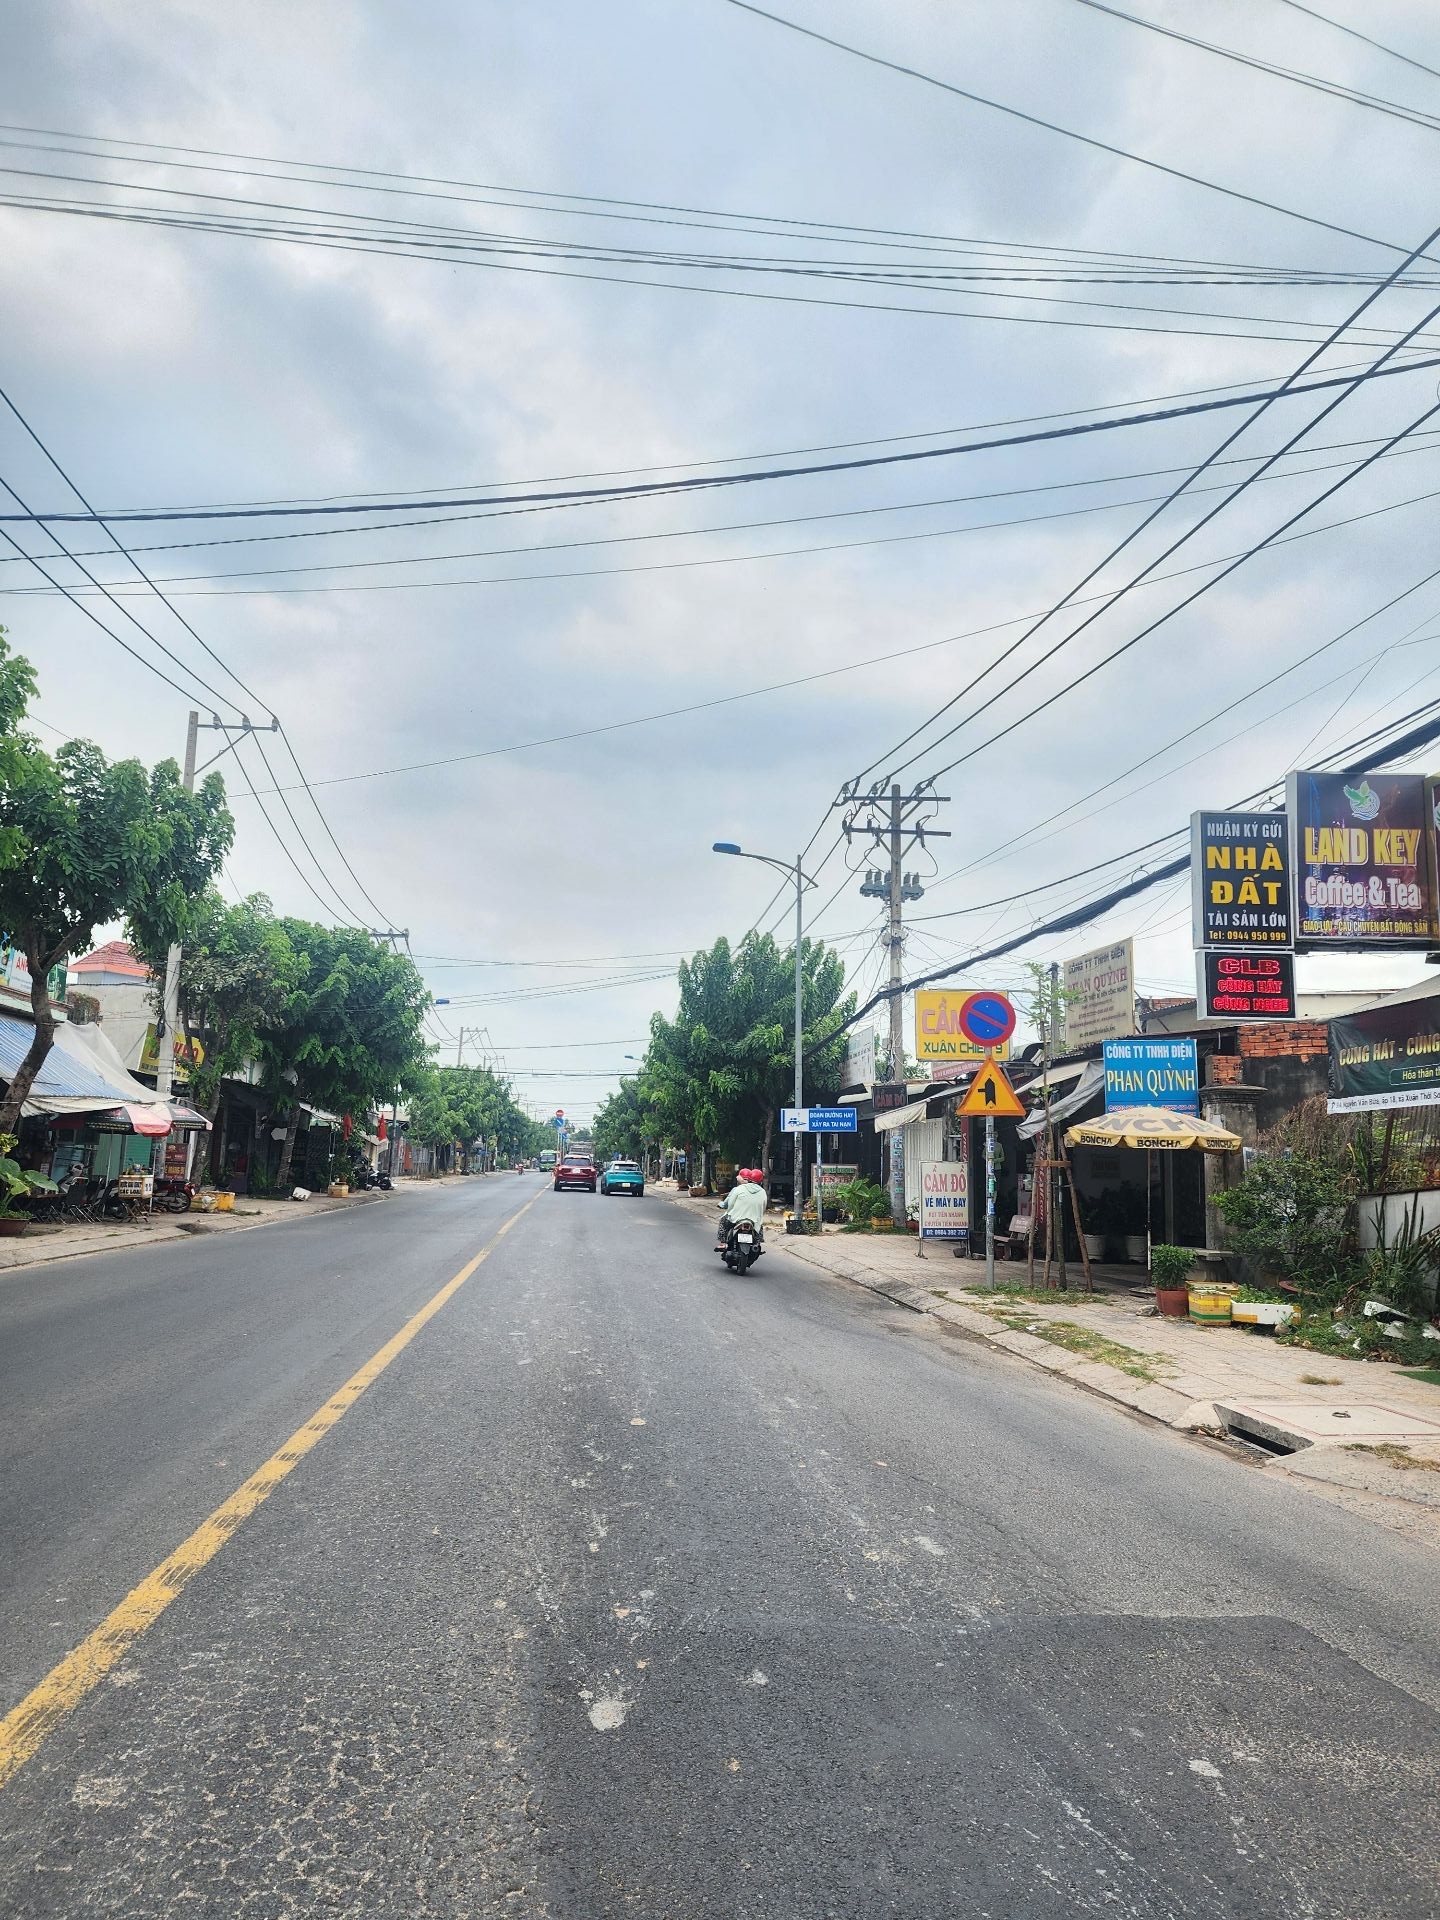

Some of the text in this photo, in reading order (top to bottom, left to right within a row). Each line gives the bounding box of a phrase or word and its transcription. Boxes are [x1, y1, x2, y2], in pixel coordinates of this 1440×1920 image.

[1207, 820, 1282, 840] NHẬN KÝ GỬI
[1207, 842, 1284, 870] NHÀ
[1305, 827, 1421, 866] LAND KEY
[1211, 873, 1282, 904] ĐẤT
[1305, 875, 1422, 909] Coffee & Tea
[1208, 910, 1287, 927] TÀI SẢN LỚN
[1209, 930, 1287, 941] Tel: 0944 950 999
[1218, 958, 1281, 975] CLB
[924, 1039, 956, 1053] XUÂN
[1106, 1042, 1192, 1060] CÔNG TY TNHH ĐIỆN
[1373, 1038, 1396, 1061] HÁT
[1107, 1062, 1195, 1097] PHAN QUỲNH
[1137, 1139, 1181, 1148] BONCHA
[924, 1164, 967, 1193] CẦM ĐỒ
[925, 1195, 967, 1208] VÉ MÁY BAY
